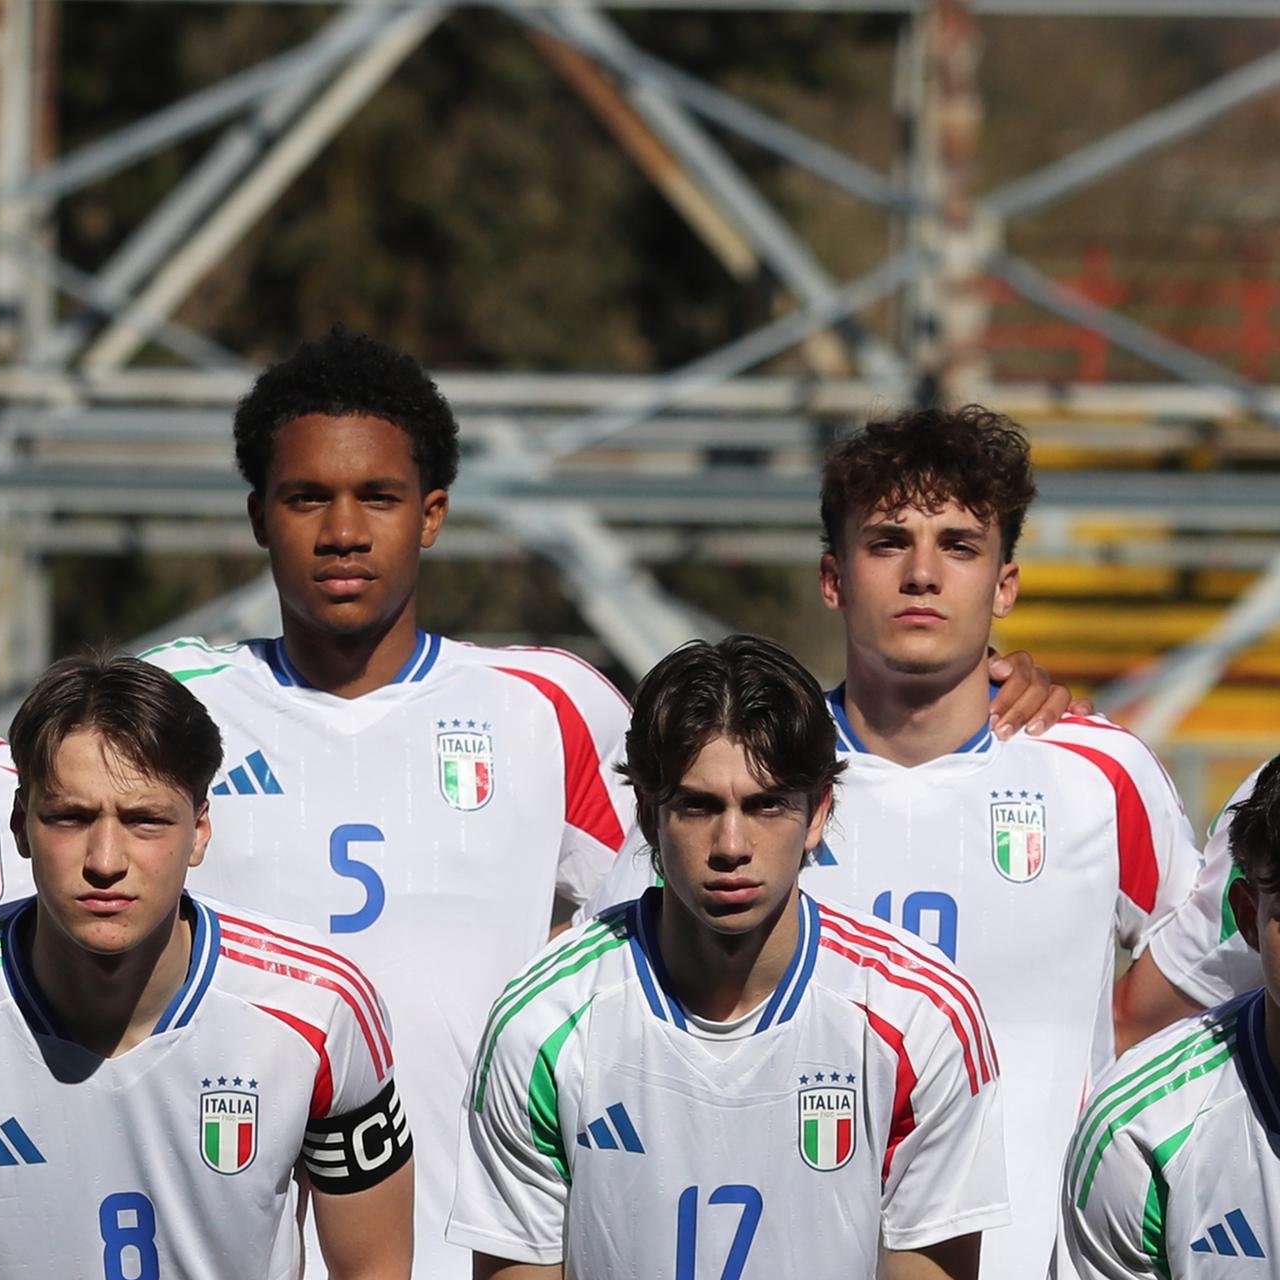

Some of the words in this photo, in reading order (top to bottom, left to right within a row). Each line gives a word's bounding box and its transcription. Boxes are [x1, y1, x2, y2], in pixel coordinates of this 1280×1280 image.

[442, 738, 486, 753] ITALIA
[995, 808, 1040, 825] ITALIA
[330, 824, 384, 933] 5
[205, 1098, 253, 1115] ITALIA
[803, 1094, 851, 1111] ITALIA
